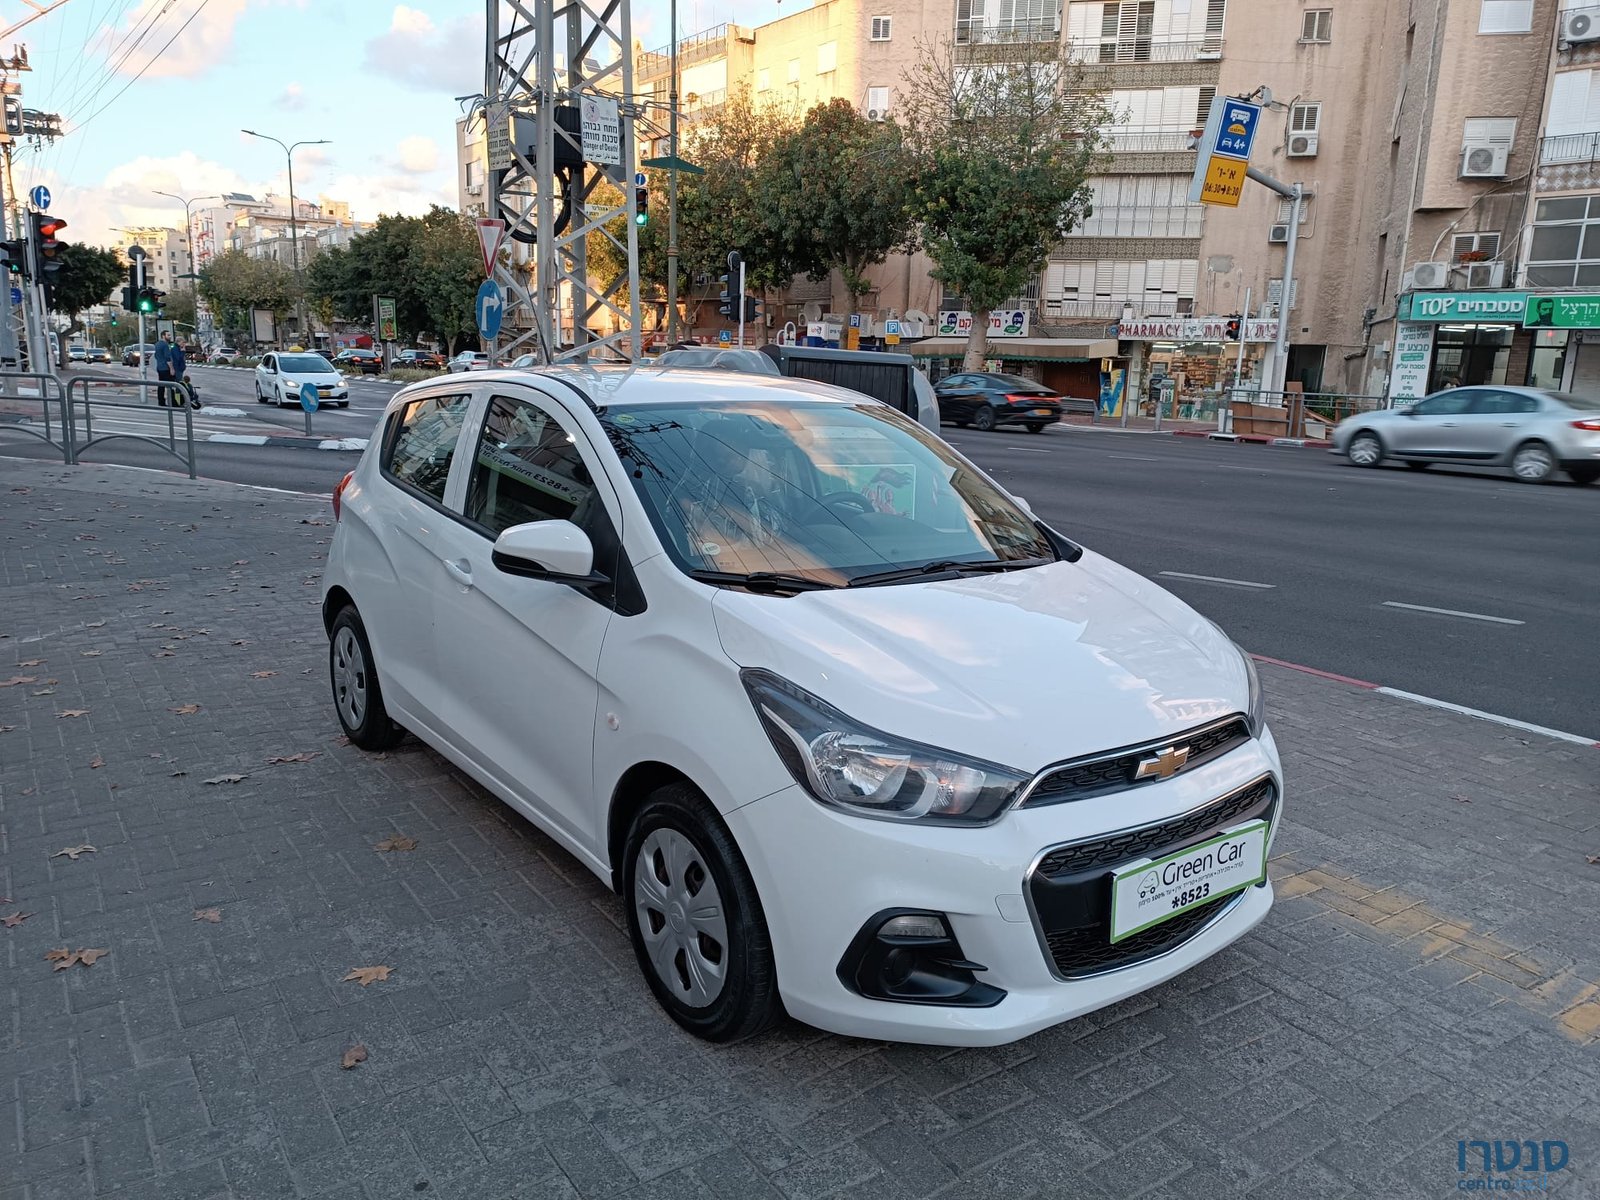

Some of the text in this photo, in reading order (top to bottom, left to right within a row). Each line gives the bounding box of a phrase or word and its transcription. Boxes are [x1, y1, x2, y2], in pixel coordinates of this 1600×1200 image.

[603, 124, 618, 134] מתח
[1233, 138, 1246, 150] 4+
[1418, 297, 1456, 316] TOP
[1118, 323, 1180, 338] PHARMACY
[1407, 343, 1430, 352] מבצע
[1162, 841, 1246, 886] Green Car
[1151, 891, 1166, 902] 100%
